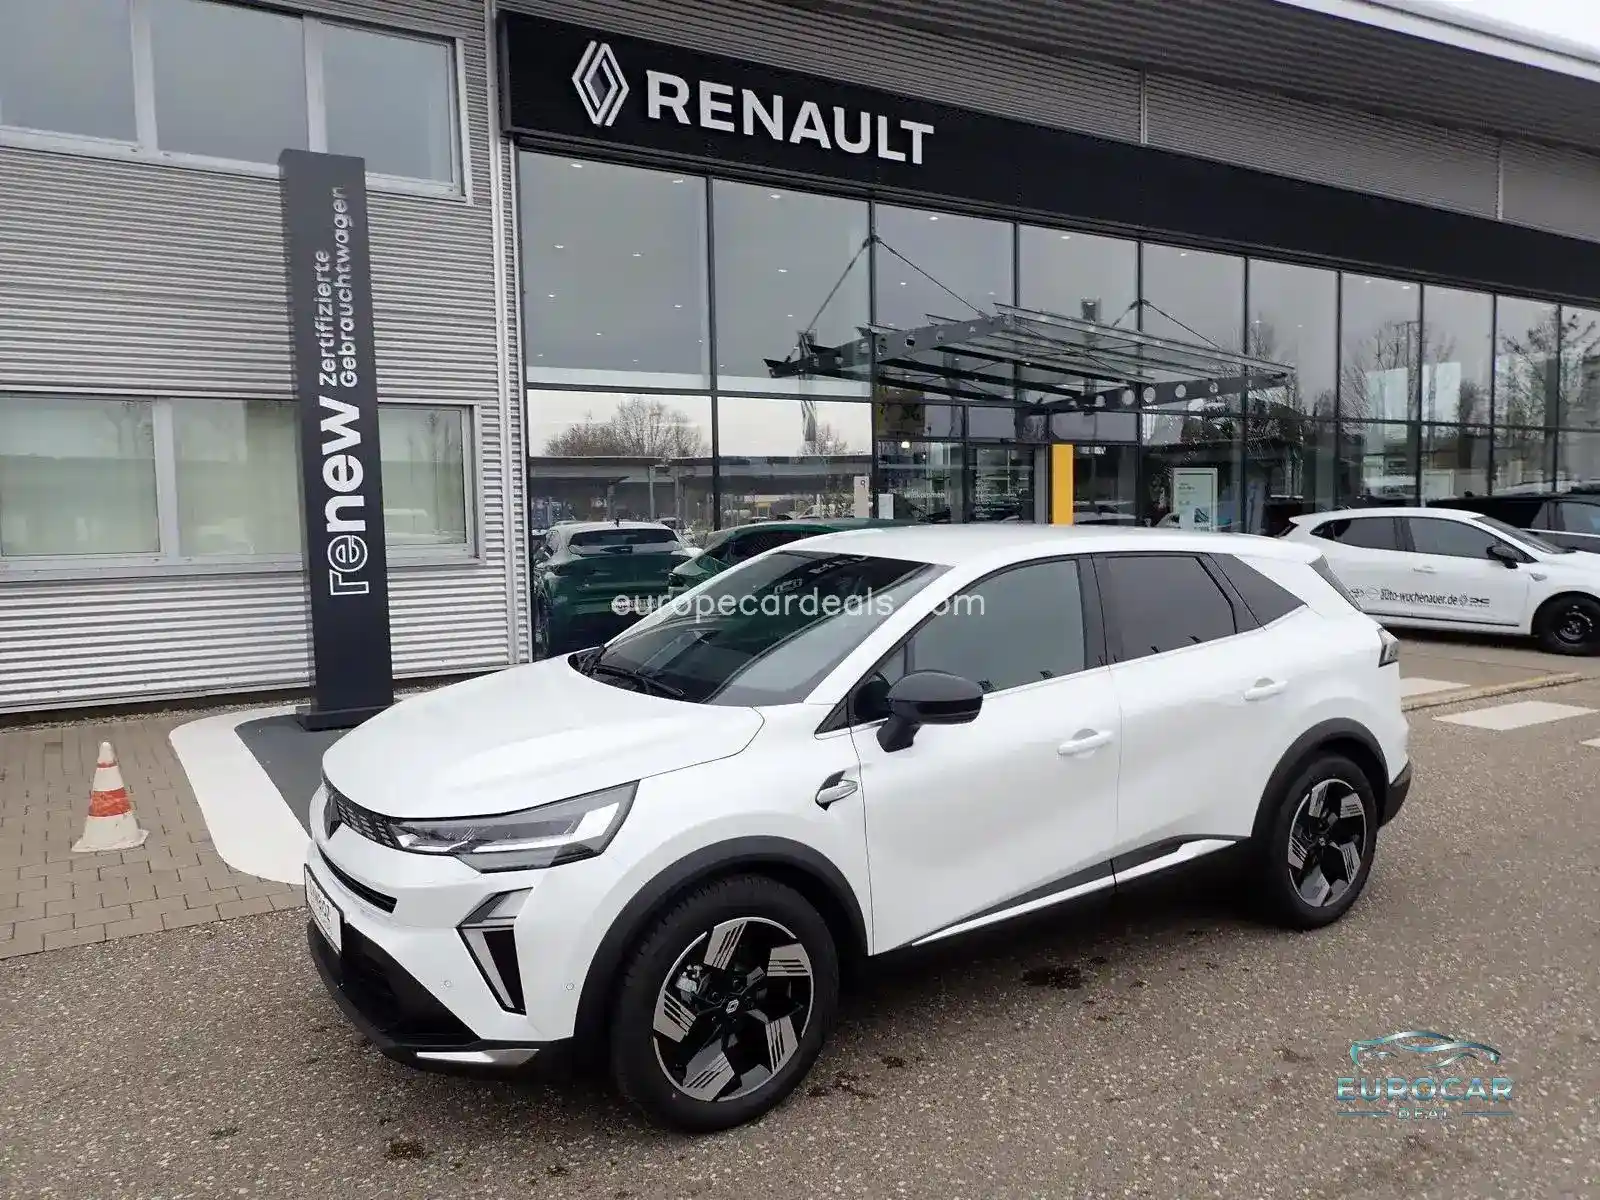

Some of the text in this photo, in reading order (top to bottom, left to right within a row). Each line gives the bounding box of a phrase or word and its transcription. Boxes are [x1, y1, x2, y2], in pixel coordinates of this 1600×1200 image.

[646, 69, 935, 165] RENAULT
[313, 250, 337, 387] Zertifizierte
[323, 186, 358, 388] Gebrauchtwagen
[319, 395, 370, 596] renew
